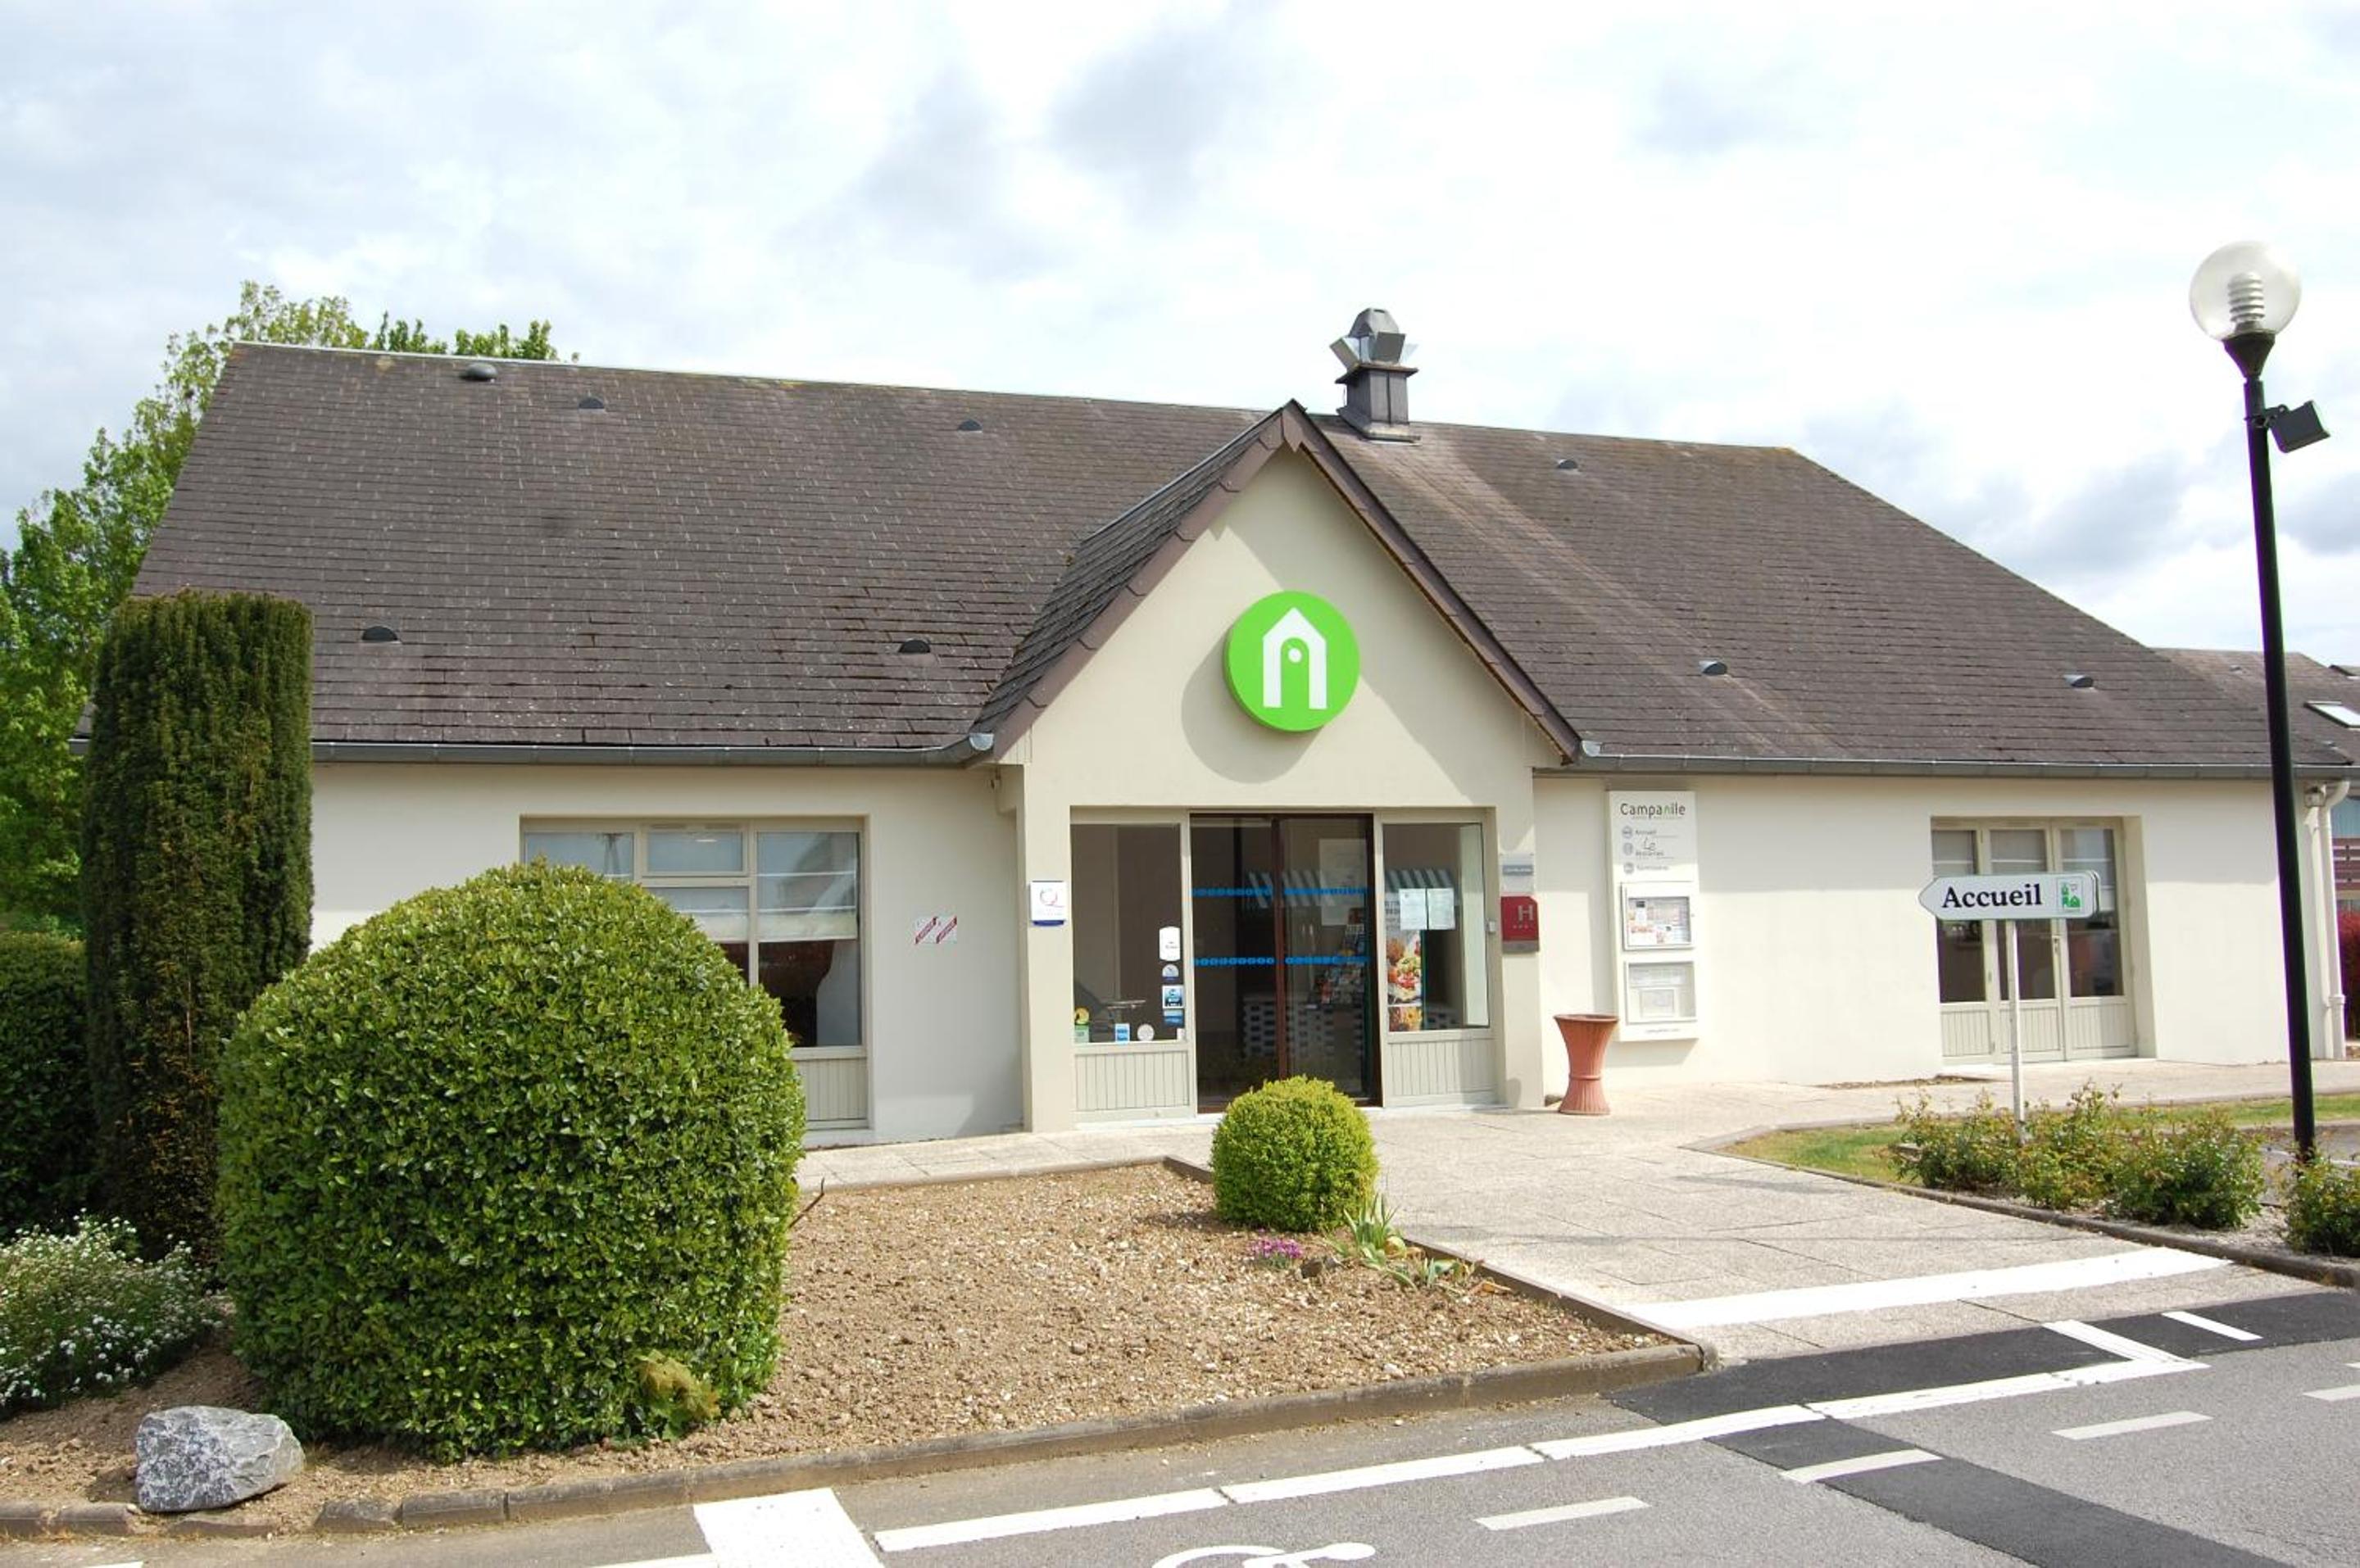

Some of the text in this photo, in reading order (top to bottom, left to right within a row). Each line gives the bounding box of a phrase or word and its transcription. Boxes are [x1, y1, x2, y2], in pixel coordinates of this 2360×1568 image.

[1620, 802, 1686, 819] Campanile
[1941, 883, 2043, 909] Accueil
[1518, 904, 1534, 921] H
